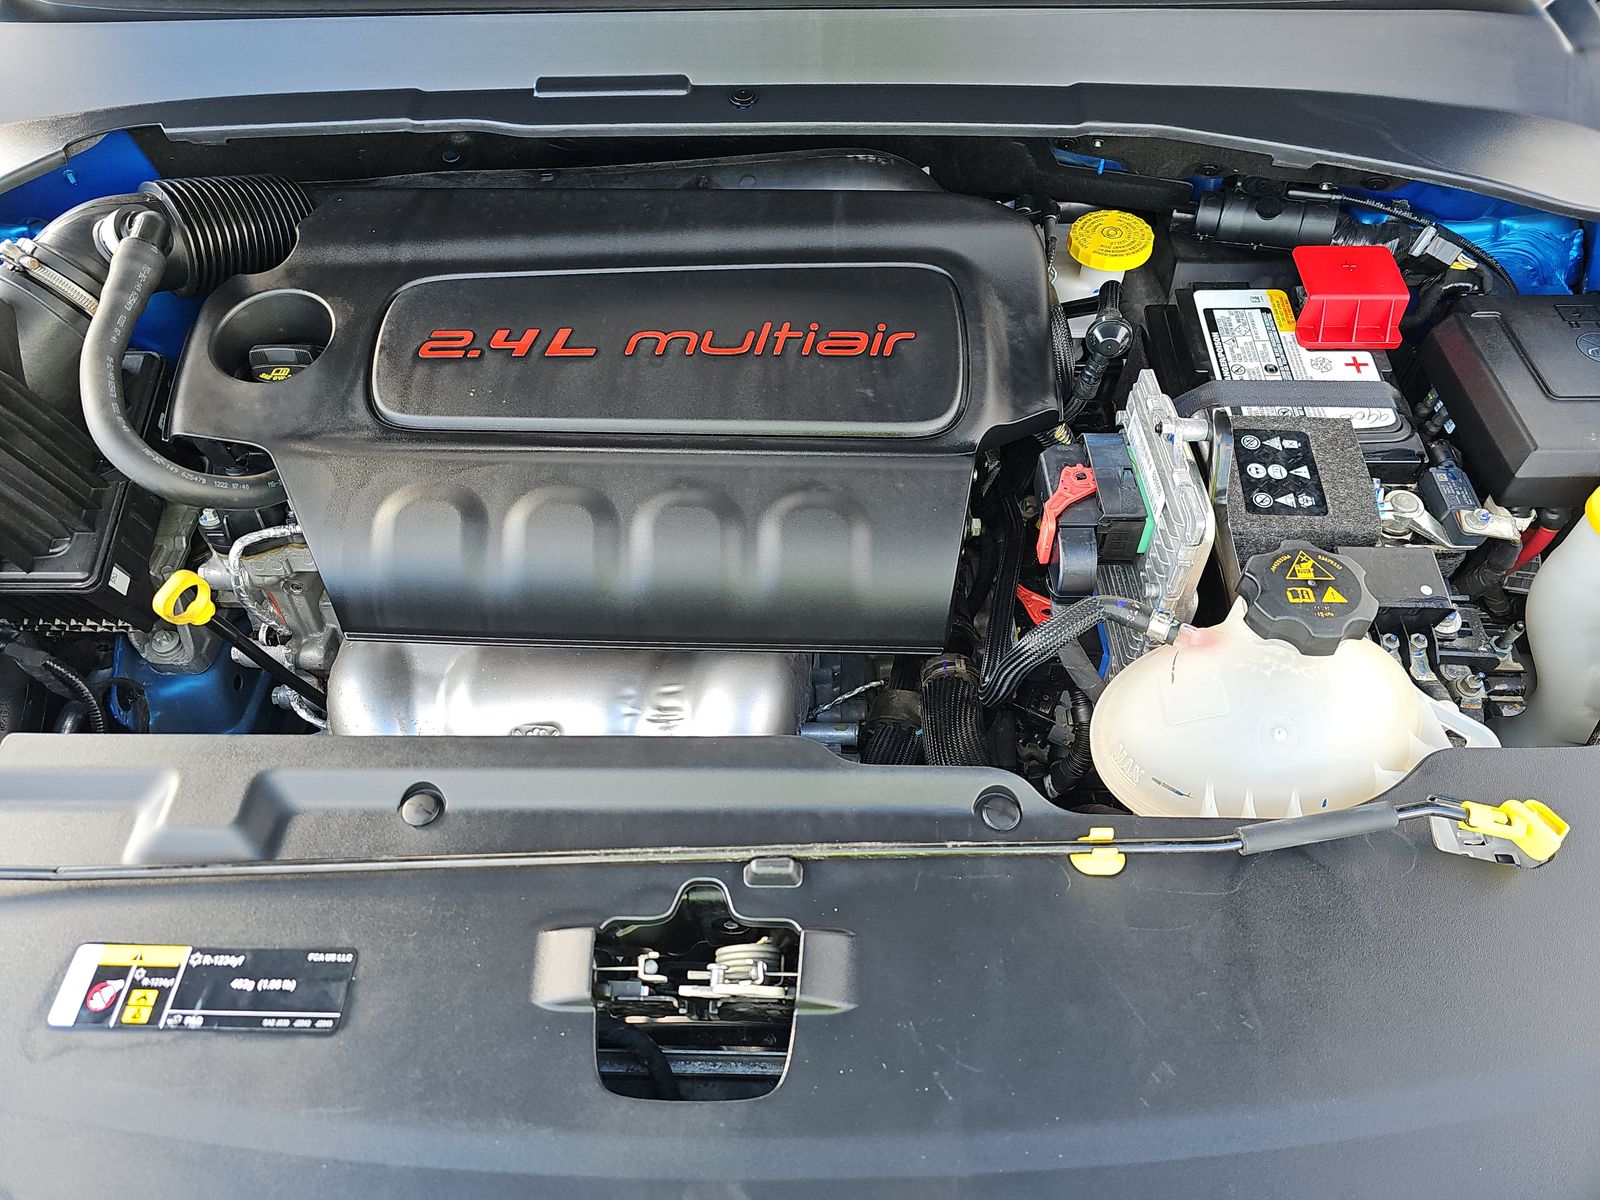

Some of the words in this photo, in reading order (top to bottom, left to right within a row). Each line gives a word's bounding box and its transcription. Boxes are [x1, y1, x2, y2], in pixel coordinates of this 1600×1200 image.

[624, 321, 916, 358] multiair
[1211, 331, 1233, 380] ANGER/POISON
[1111, 743, 1142, 784] MAX
